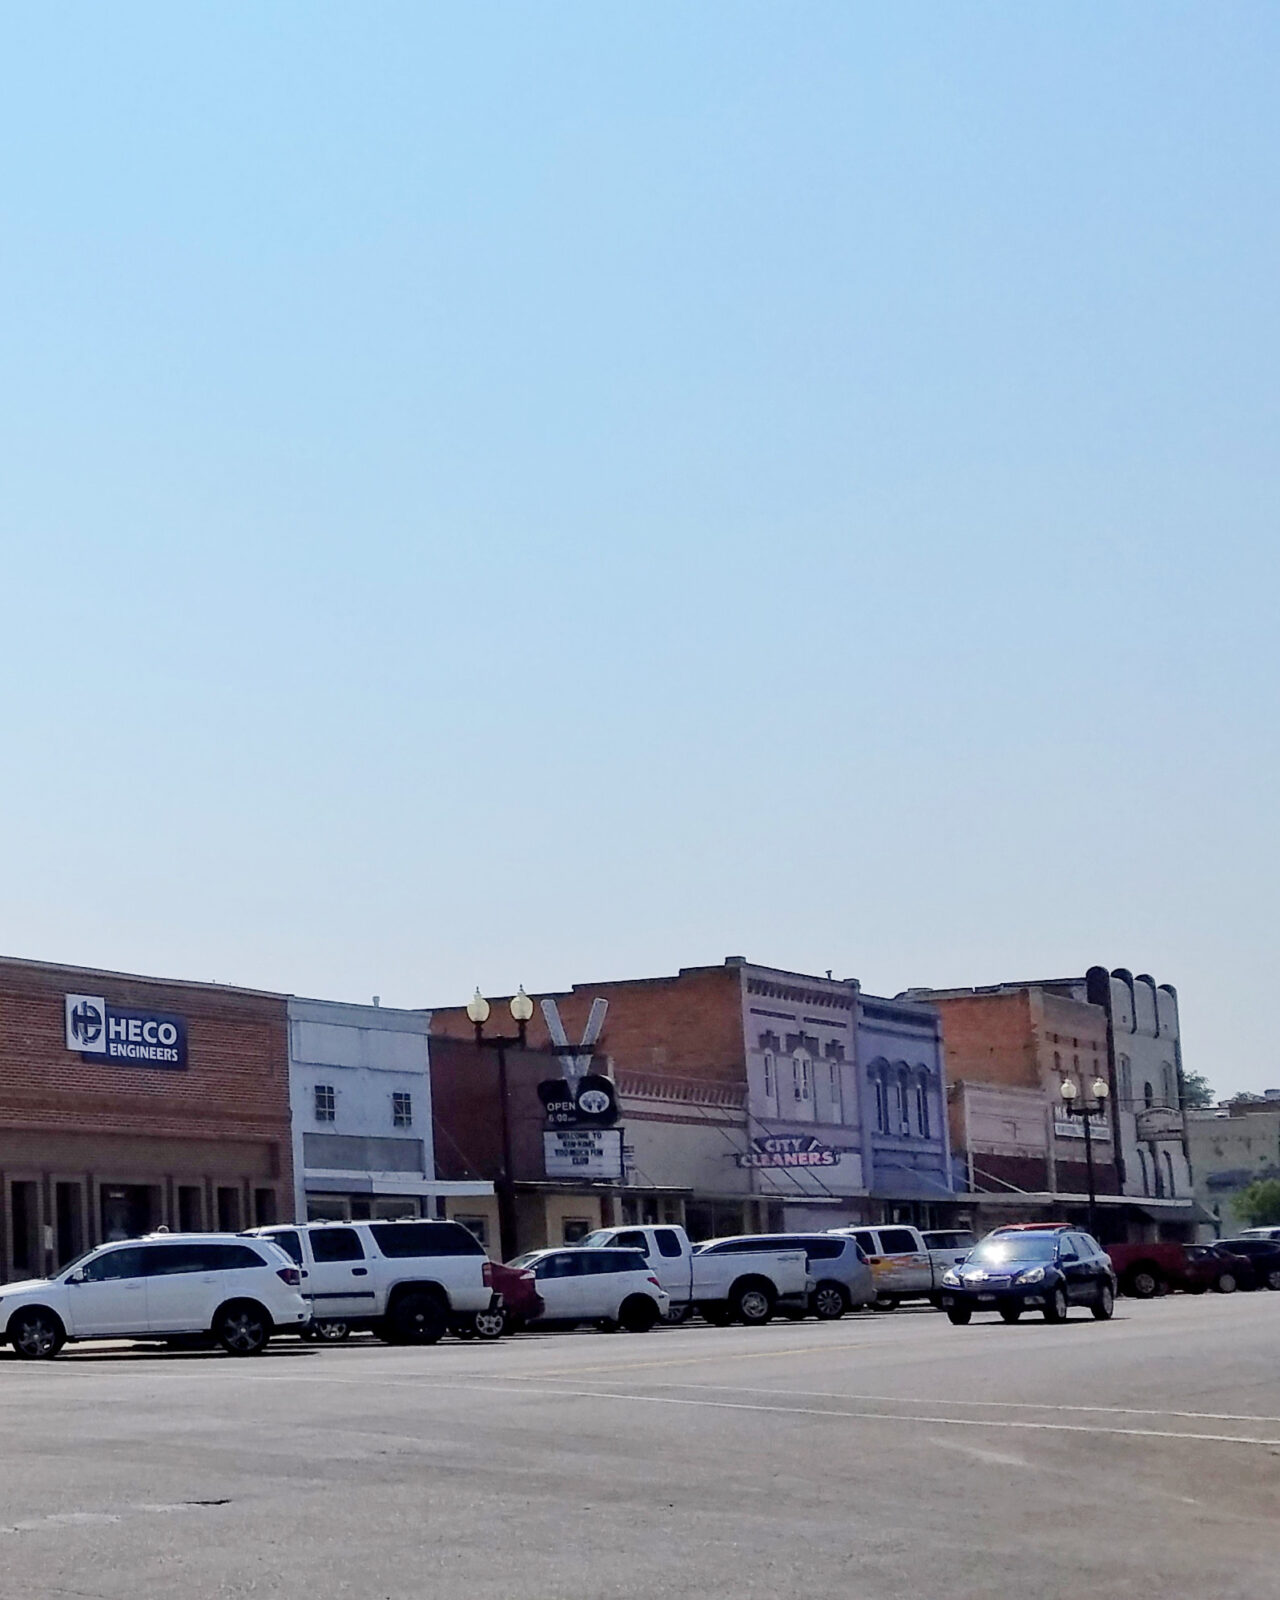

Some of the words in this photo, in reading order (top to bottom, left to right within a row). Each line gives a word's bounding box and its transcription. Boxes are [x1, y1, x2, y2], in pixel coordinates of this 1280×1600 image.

[109, 1018, 177, 1045] HECO
[110, 1043, 178, 1061] ENGINEERS
[547, 1102, 576, 1111] OPEN
[765, 1139, 802, 1151] CITY
[741, 1152, 833, 1166] CLEANERS
